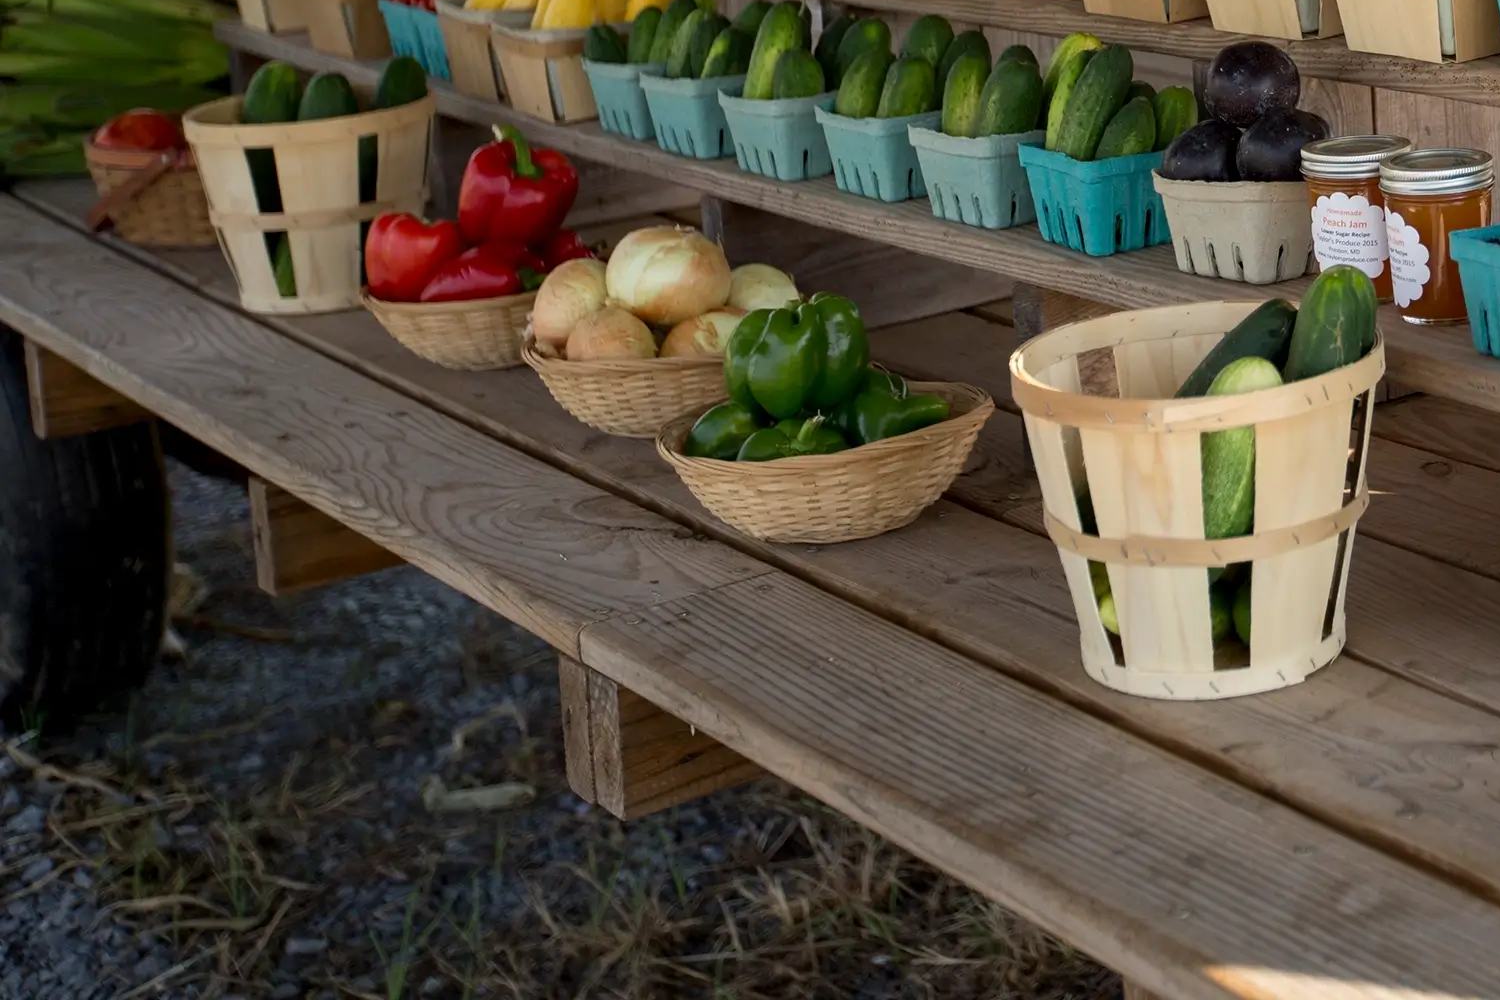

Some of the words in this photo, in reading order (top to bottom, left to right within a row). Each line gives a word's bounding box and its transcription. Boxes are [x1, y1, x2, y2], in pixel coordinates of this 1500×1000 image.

[1327, 207, 1362, 216] Homemade
[1322, 217, 1346, 228] Peach
[1349, 220, 1368, 228] Jam
[1335, 230, 1350, 238] Sugar
[1335, 238, 1361, 247] Produce
